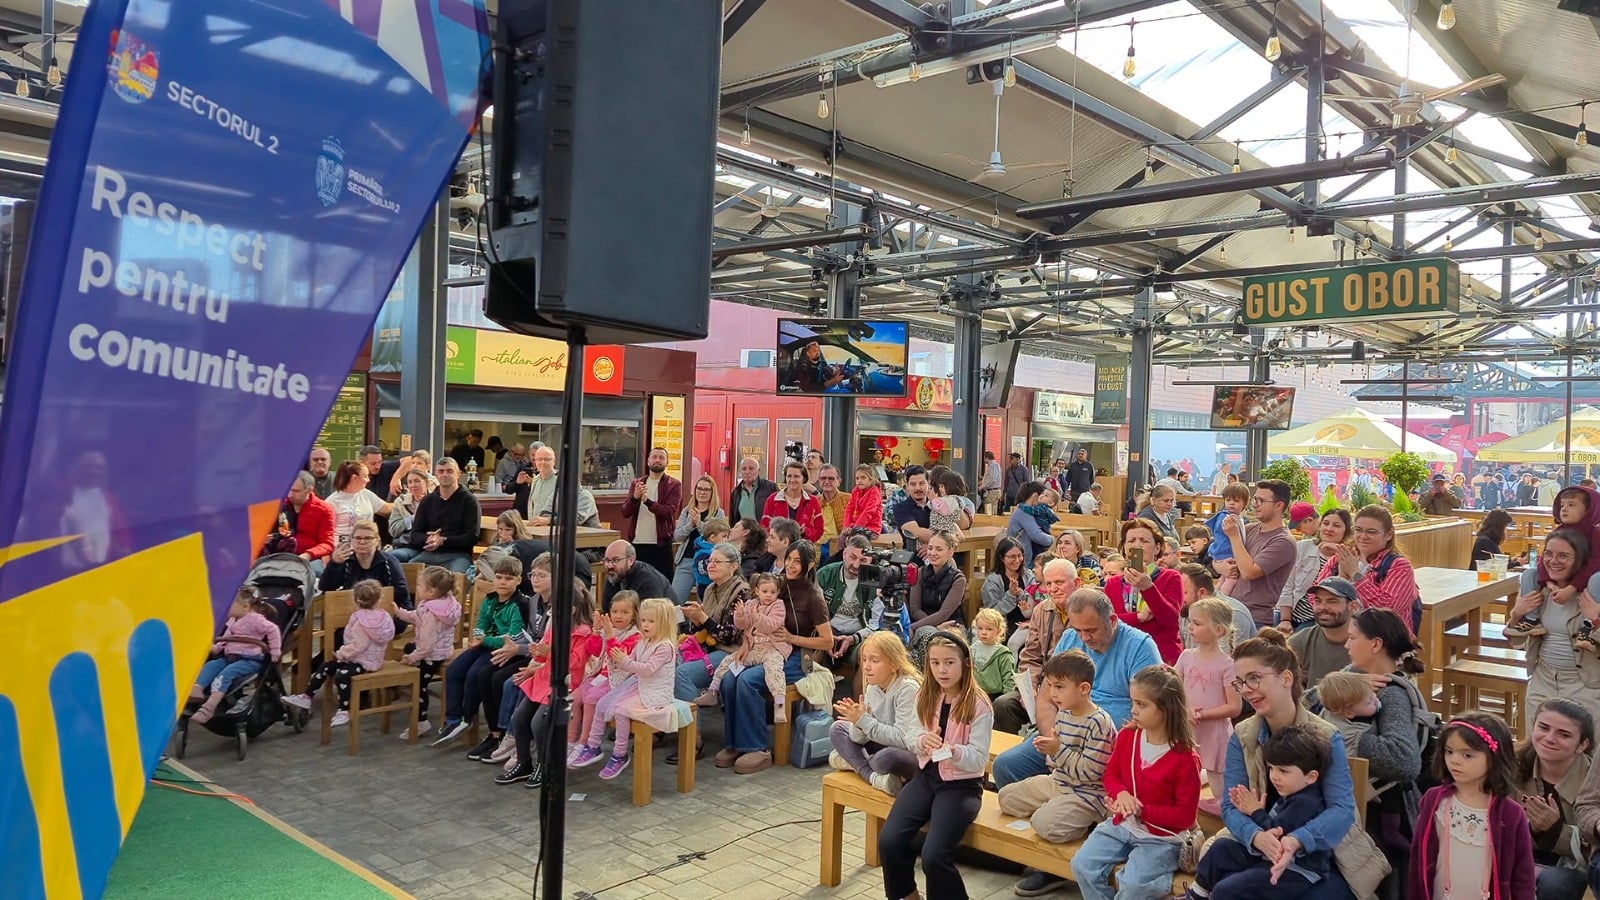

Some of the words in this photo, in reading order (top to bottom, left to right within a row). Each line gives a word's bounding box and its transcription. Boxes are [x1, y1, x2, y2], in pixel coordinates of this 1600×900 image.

[167, 80, 265, 149] SECTORUL
[267, 135, 280, 156] 2
[91, 164, 267, 271] Respect
[78, 245, 229, 324] pentru
[1246, 277, 1330, 319] GUST
[1343, 266, 1440, 311] OBOR
[68, 322, 311, 403] comunitate
[481, 348, 537, 367] italian
[533, 353, 567, 374] job
[1578, 453, 1598, 462] OBOR
